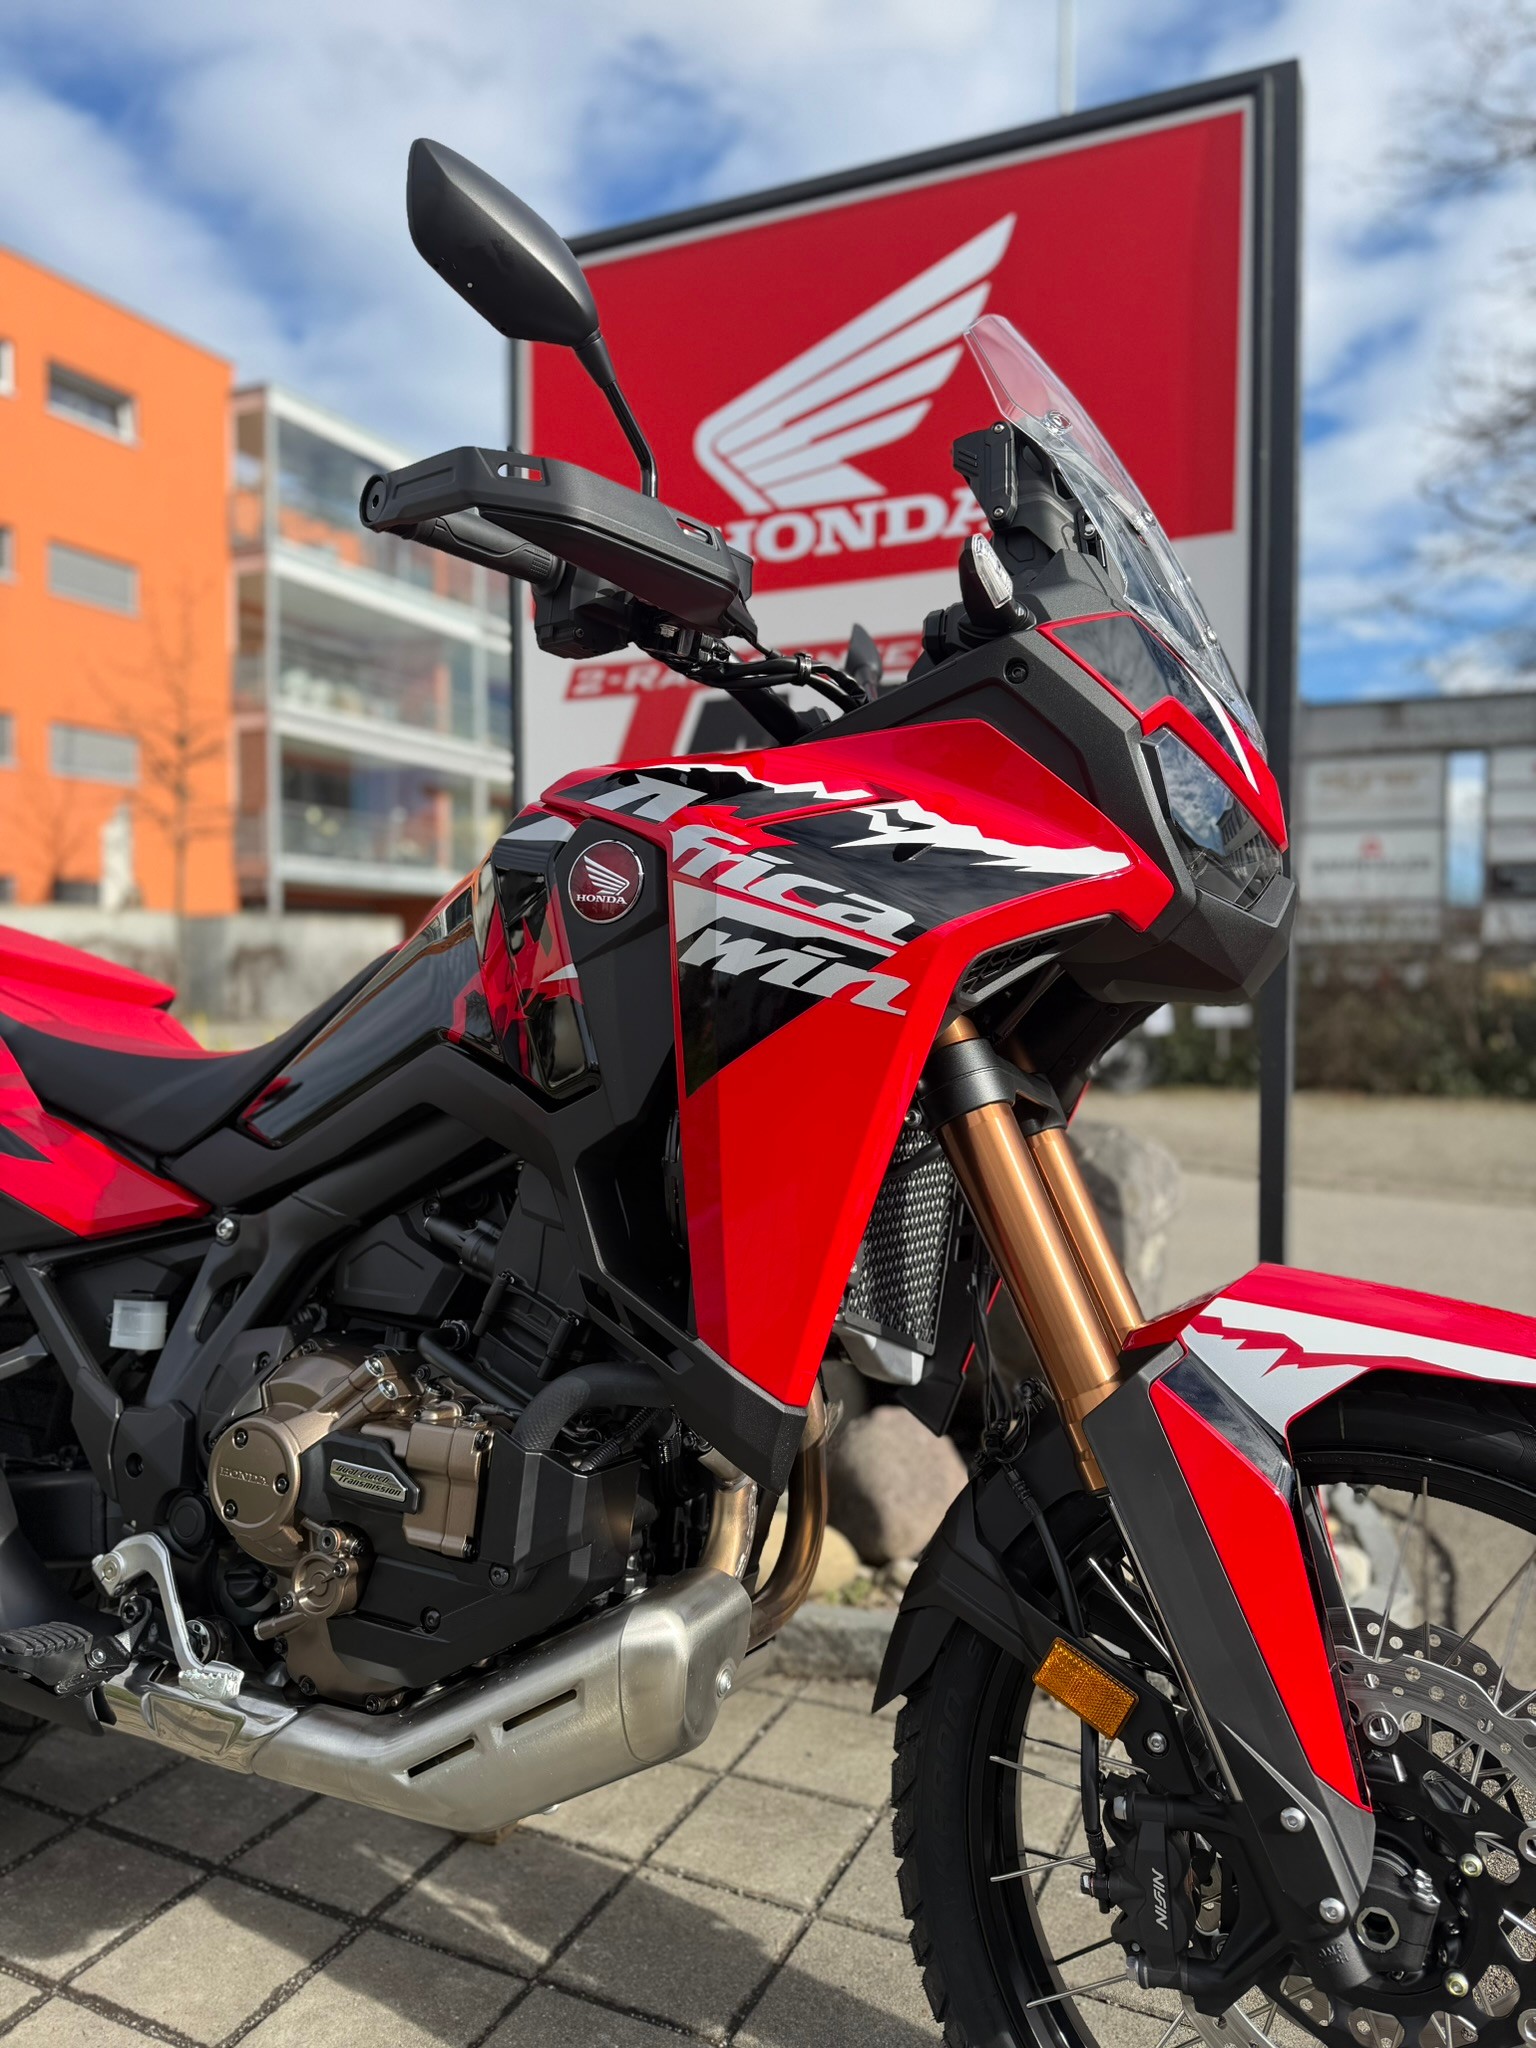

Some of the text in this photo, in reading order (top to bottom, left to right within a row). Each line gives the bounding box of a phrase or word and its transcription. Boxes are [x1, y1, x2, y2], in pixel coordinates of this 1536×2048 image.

[576, 893, 628, 905] HONDA
[220, 1466, 269, 1487] HONDA
[335, 1465, 391, 1484] Dual Clutch
[338, 1474, 402, 1497] Transmission
